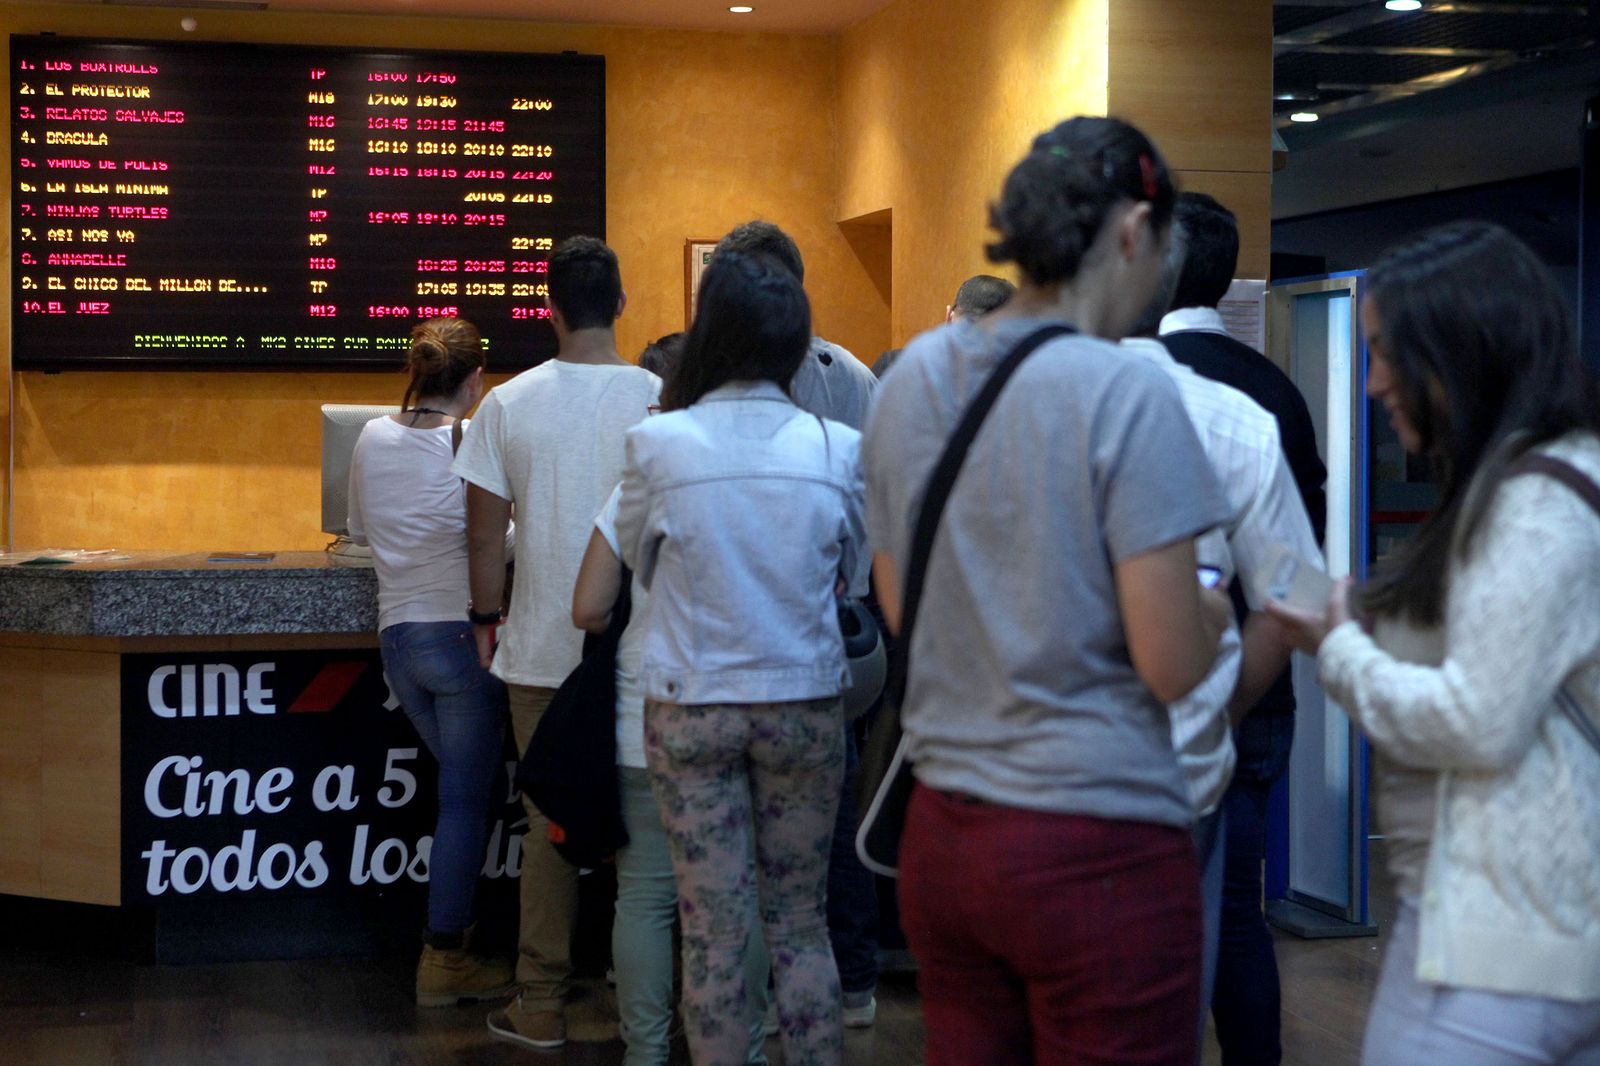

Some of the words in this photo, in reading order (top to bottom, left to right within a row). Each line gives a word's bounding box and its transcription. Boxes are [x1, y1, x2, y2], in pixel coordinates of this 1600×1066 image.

[134, 334, 229, 348] BIENVENIDOS
[144, 755, 295, 818] Cine
[311, 764, 360, 812] a
[376, 747, 419, 808] 5
[141, 829, 329, 896] todos
[348, 824, 431, 887] los
